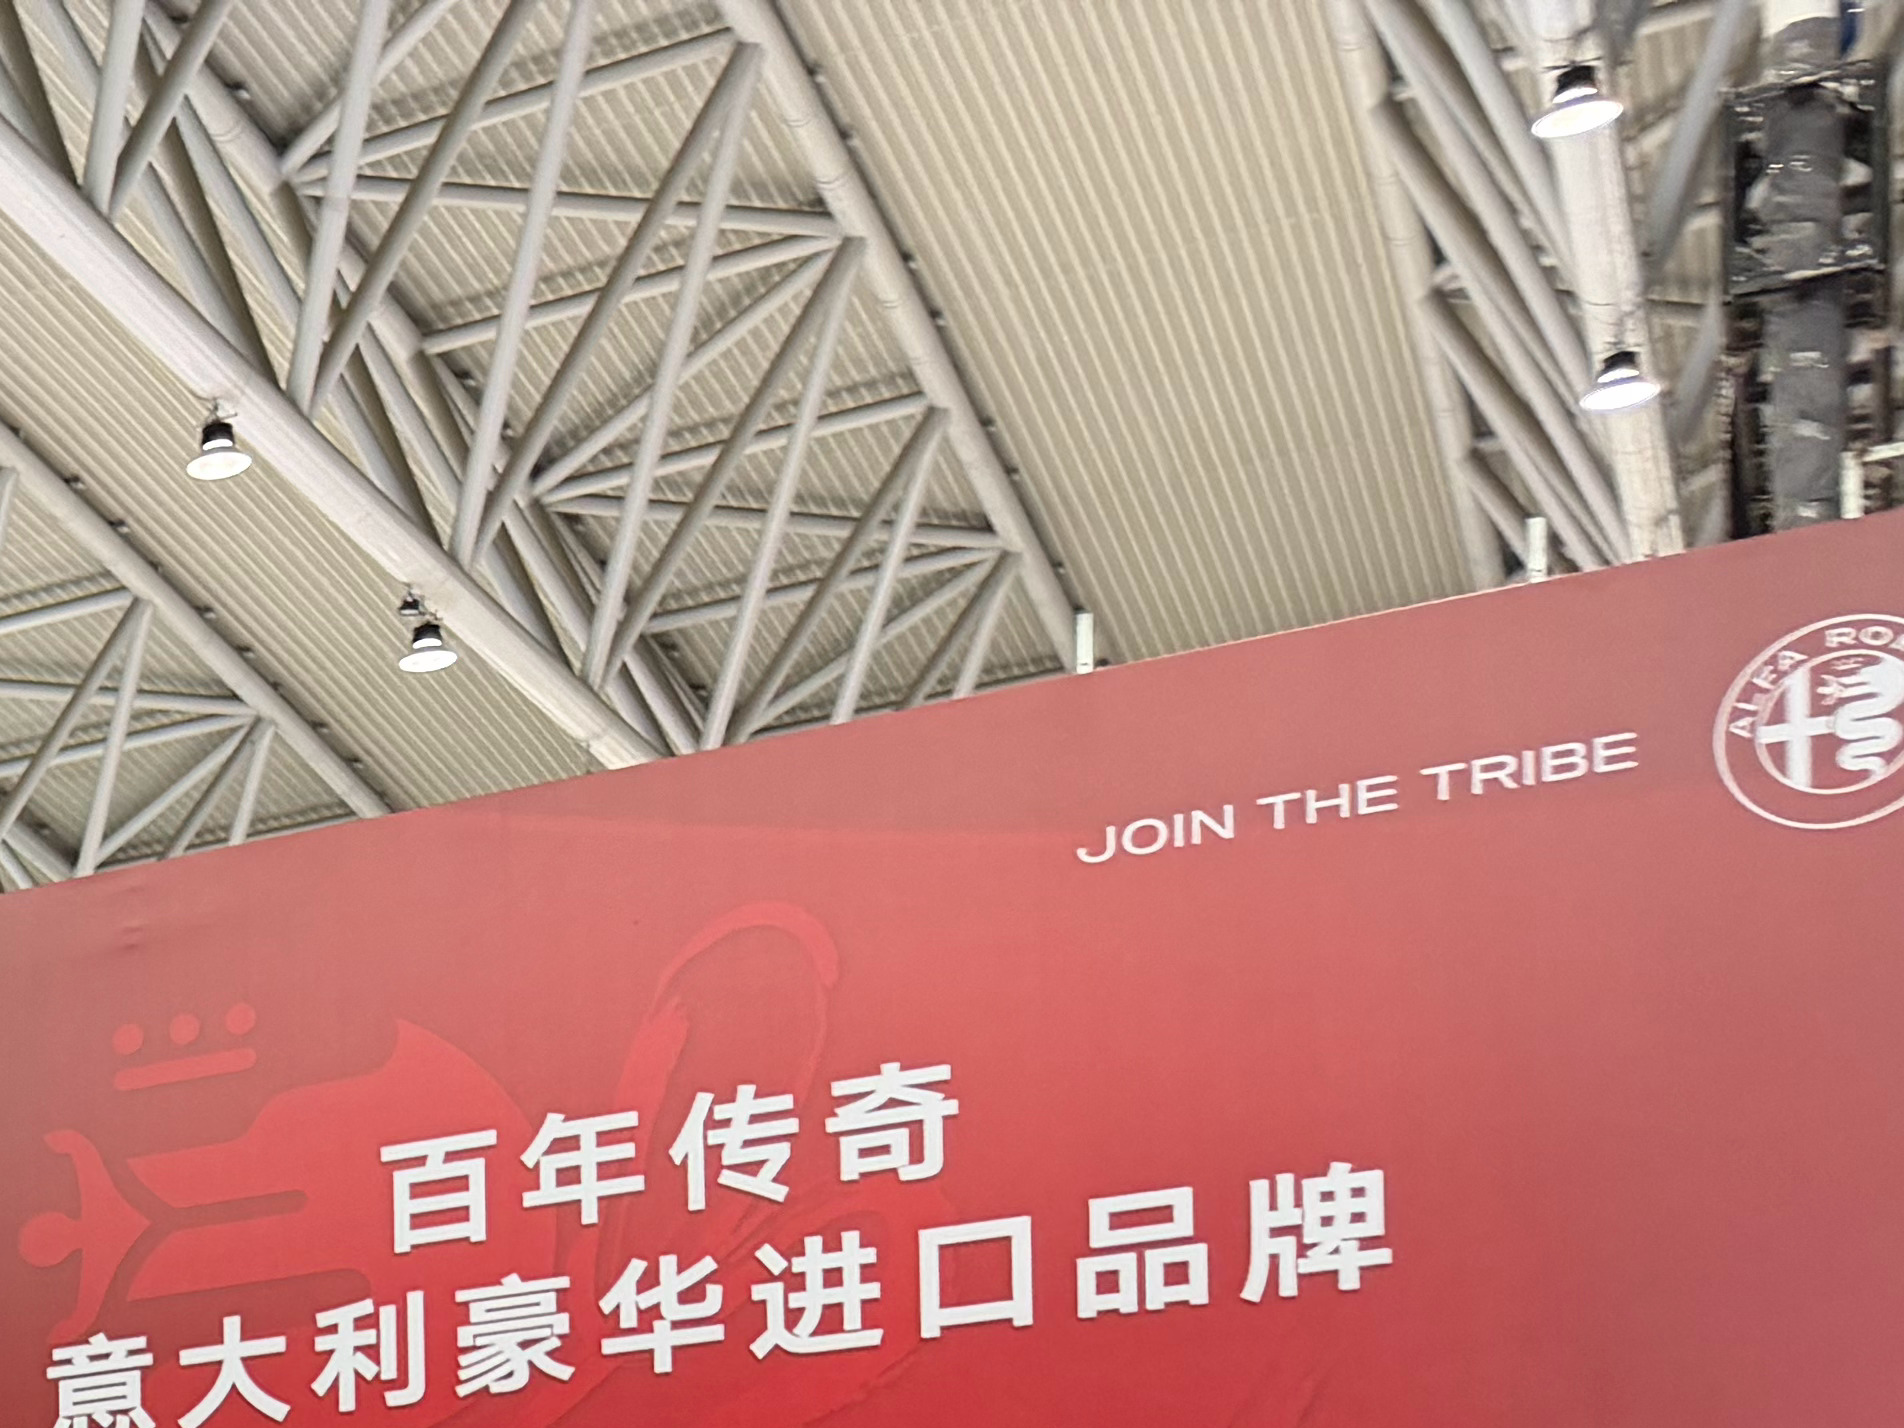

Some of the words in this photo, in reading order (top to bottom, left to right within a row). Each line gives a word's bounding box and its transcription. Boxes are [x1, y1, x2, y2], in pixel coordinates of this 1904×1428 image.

[1075, 803, 1235, 864] JOIN
[1255, 774, 1399, 831] THE
[1419, 731, 1640, 802] TRIBE
[380, 1060, 961, 1255] 百年传奇
